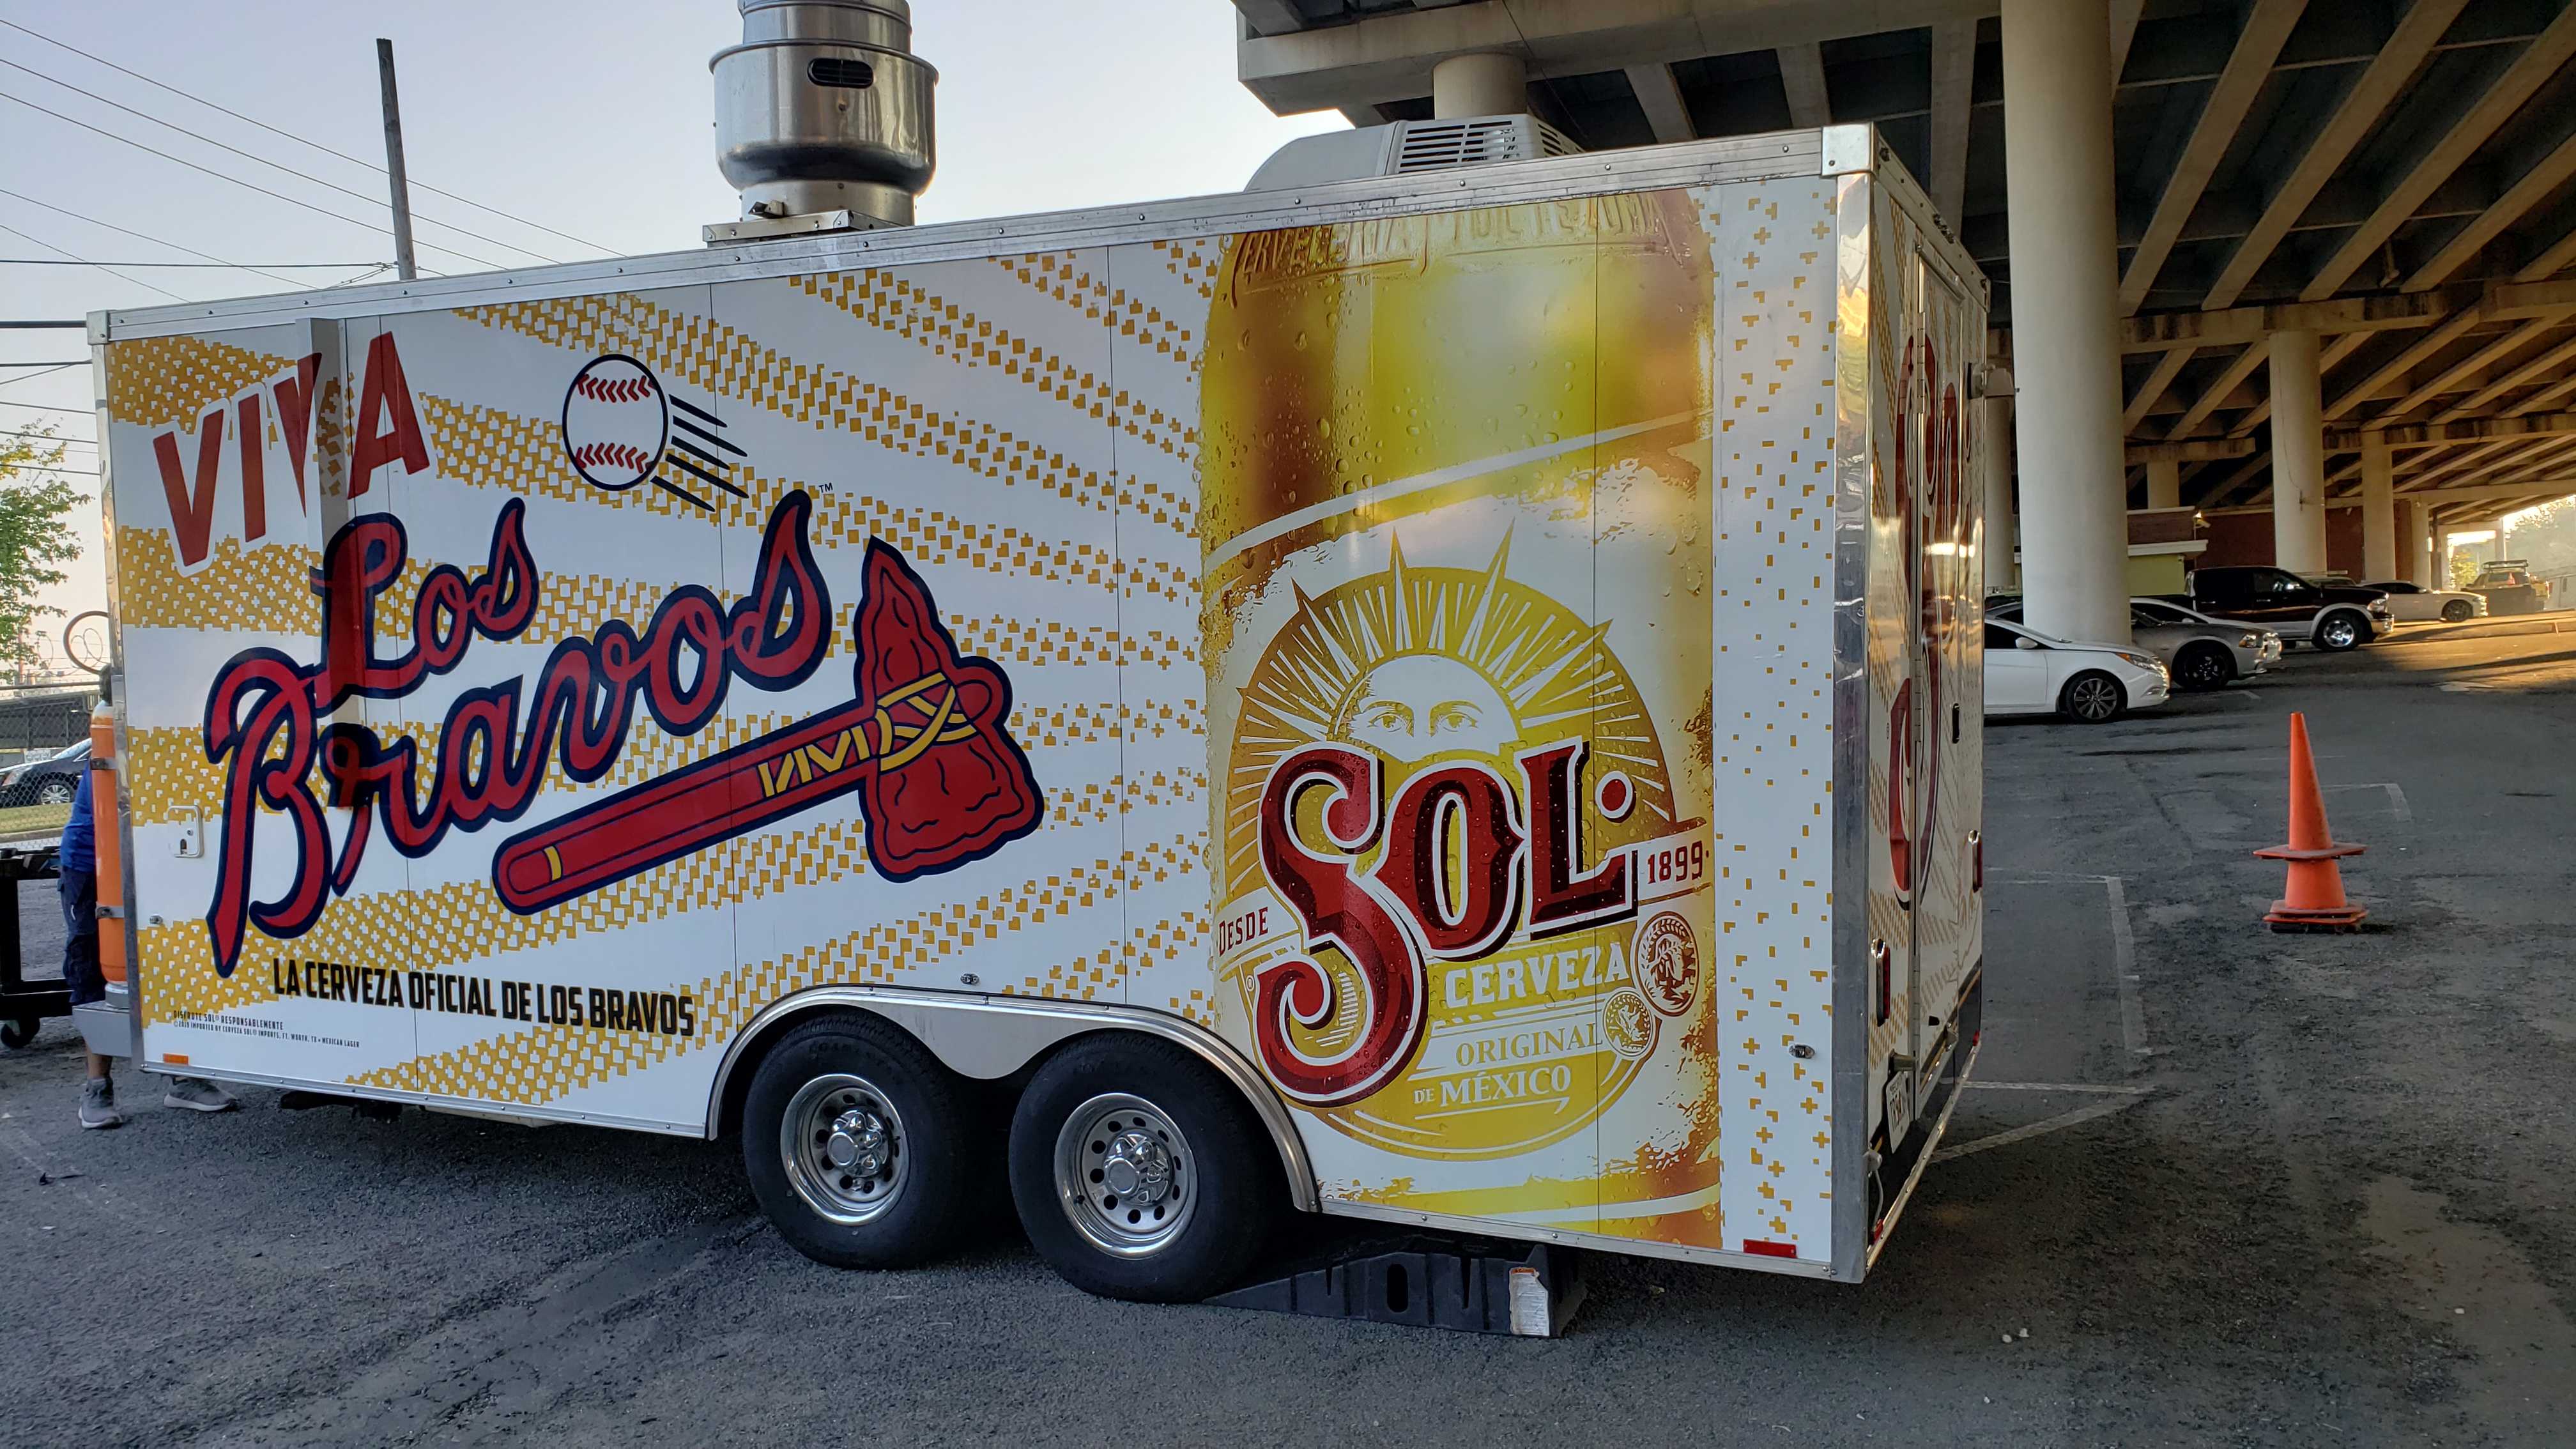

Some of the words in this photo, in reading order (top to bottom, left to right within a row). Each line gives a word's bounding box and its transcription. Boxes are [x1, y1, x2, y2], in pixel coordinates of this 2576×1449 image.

[152, 330, 430, 567] VIVA
[309, 496, 540, 719] Los
[203, 489, 833, 979] Bravos
[1646, 839, 1704, 885] 1899
[1218, 906, 1269, 958] DESDE
[1256, 735, 1639, 1110] SOL
[272, 958, 302, 997] LA
[305, 960, 405, 1009] CERVEZA
[407, 970, 498, 1018] OFICIAL
[501, 980, 533, 1022] DE
[536, 983, 584, 1027] LOS
[588, 986, 695, 1037] BRAVOS
[1445, 941, 1630, 1009] CERVEZA
[220, 1015, 284, 1031] RESPONSABLEMENTE
[1455, 1022, 1604, 1068] ORIGINAL
[1413, 1087, 1436, 1105] DE
[1439, 1064, 1572, 1107] MÉXICO
